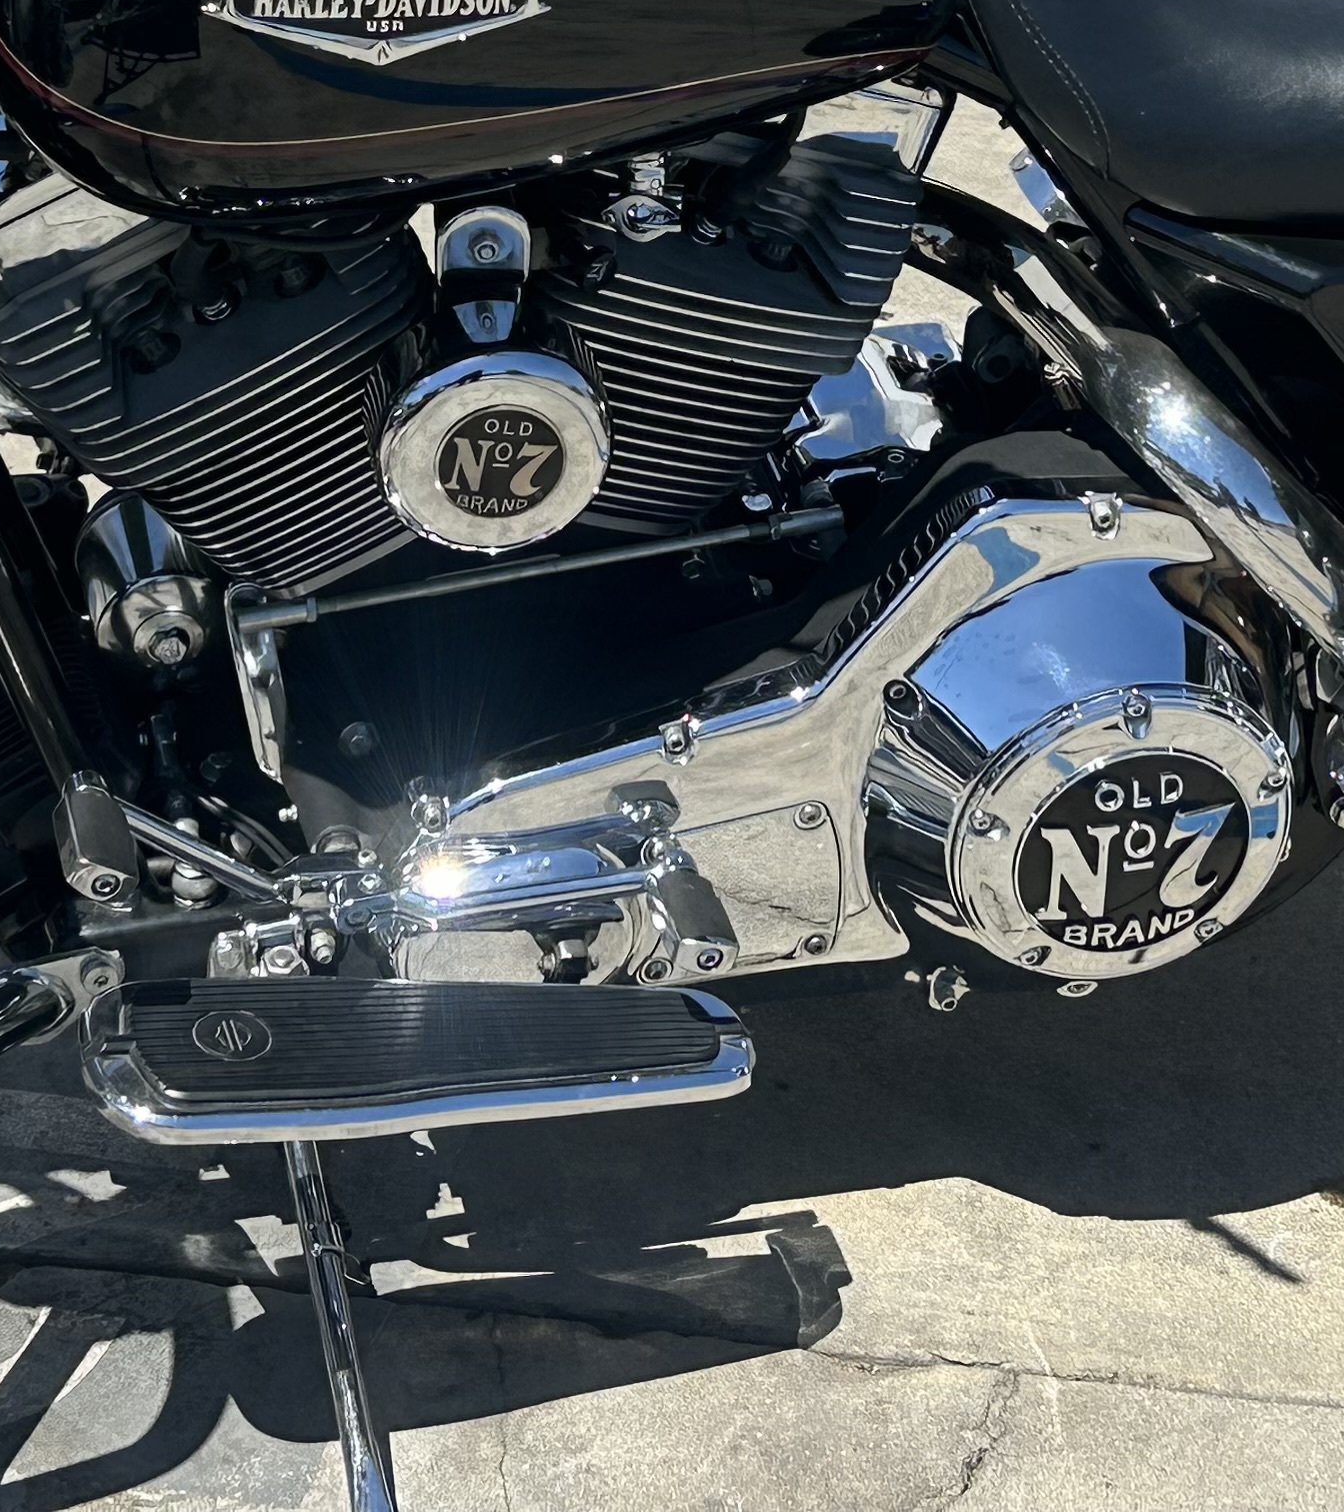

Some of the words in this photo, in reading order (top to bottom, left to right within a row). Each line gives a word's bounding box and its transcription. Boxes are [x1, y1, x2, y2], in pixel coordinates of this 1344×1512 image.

[366, 20, 404, 33] USA
[484, 418, 533, 436] OLD
[456, 495, 529, 515] BRAND
[1094, 771, 1183, 813] OLD
[1063, 908, 1195, 949] BRAND
